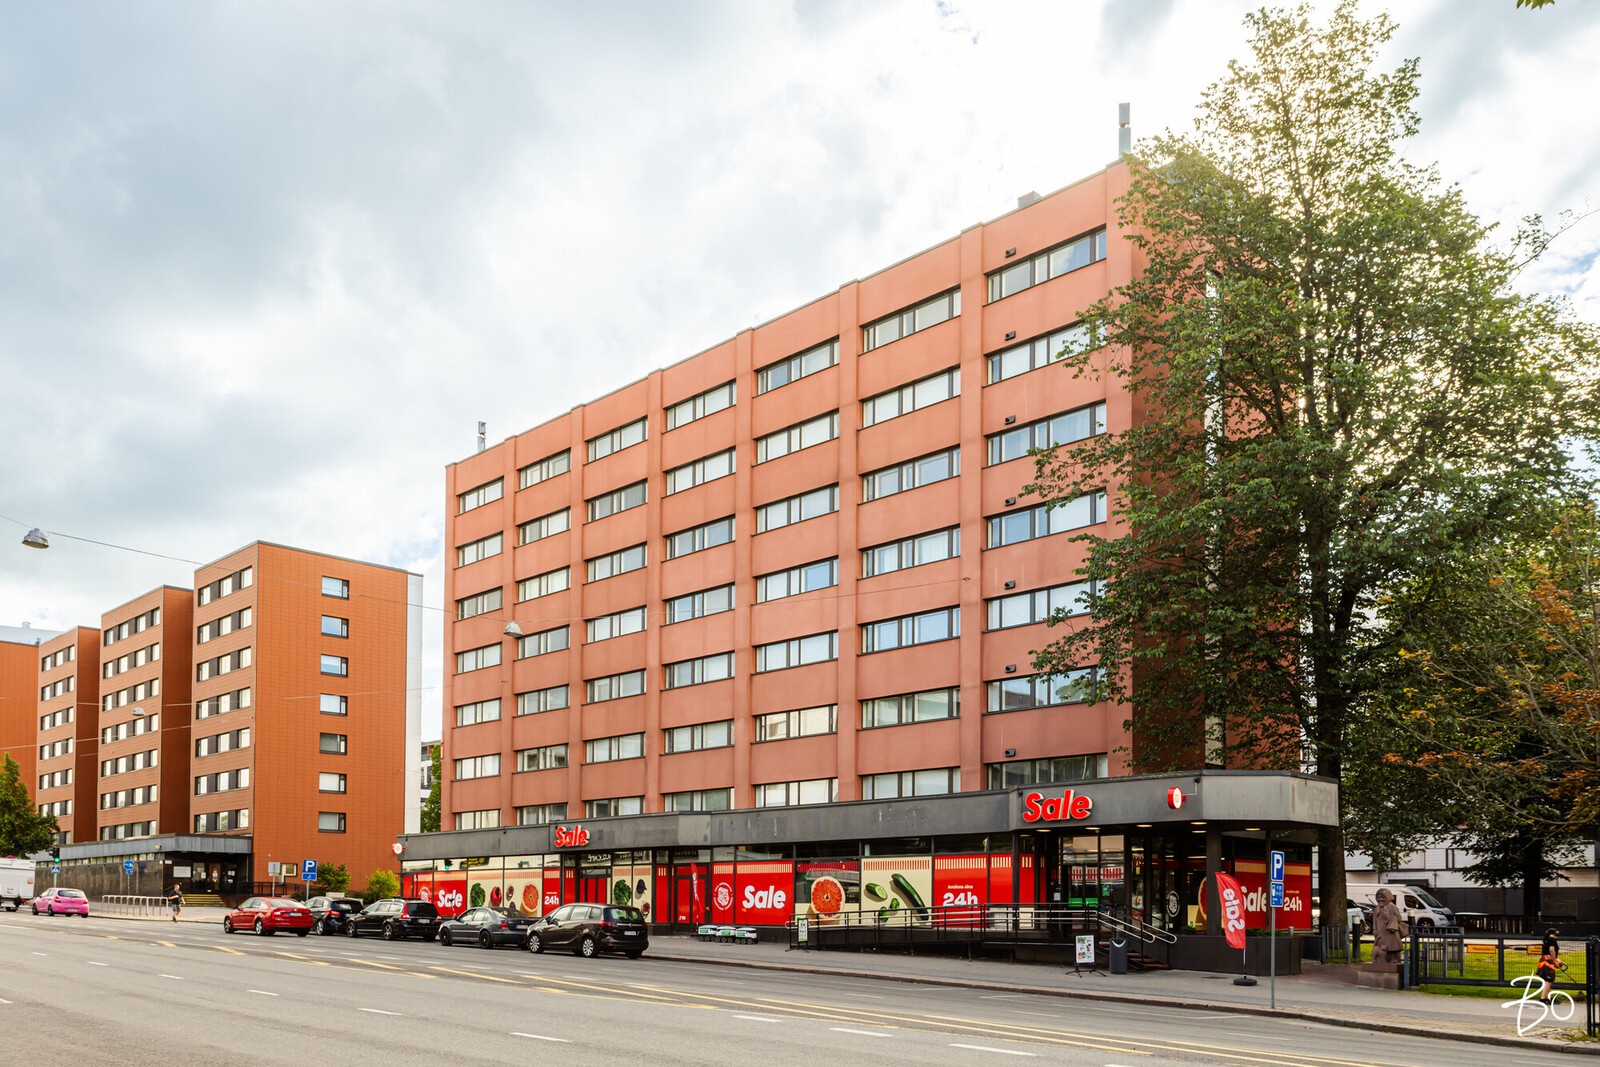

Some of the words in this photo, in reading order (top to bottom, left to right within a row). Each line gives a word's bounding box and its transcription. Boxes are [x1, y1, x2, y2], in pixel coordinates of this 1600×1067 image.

[1022, 789, 1092, 823] Sale
[554, 825, 590, 848] Sale
[305, 861, 315, 872] P
[1273, 854, 1283, 878] P
[436, 889, 462, 908] Sale
[544, 895, 560, 905] 24h
[742, 885, 787, 909] Sale
[943, 892, 979, 908] 24h
[1283, 896, 1303, 912] 24h
